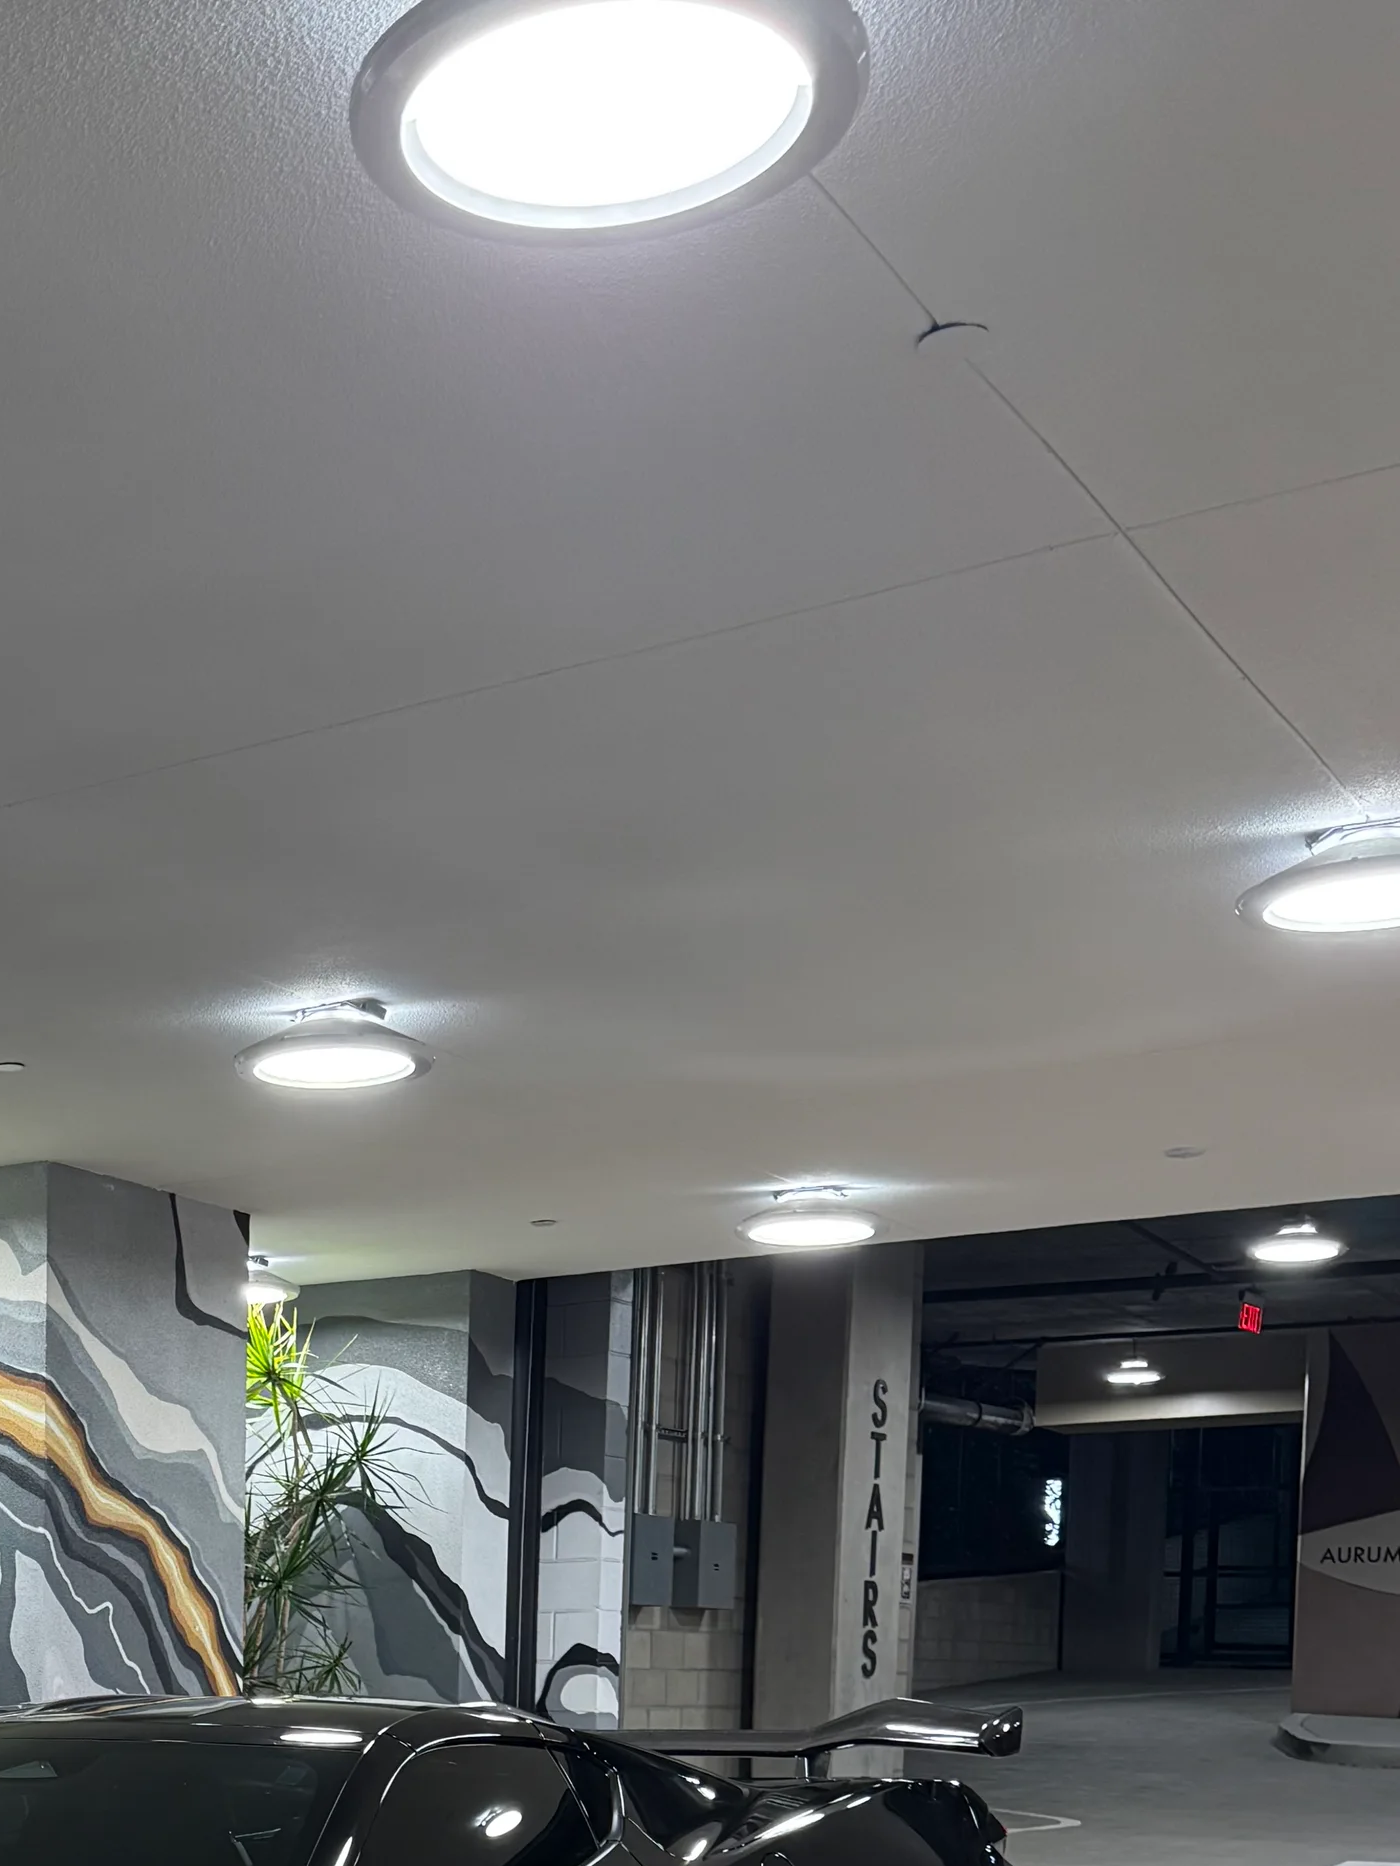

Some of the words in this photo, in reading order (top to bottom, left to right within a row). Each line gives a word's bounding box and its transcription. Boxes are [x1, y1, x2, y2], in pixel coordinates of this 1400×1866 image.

[1242, 1303, 1260, 1332] EXIT
[861, 1379, 888, 1679] STAIRS
[1320, 1546, 1400, 1564] AURUM
